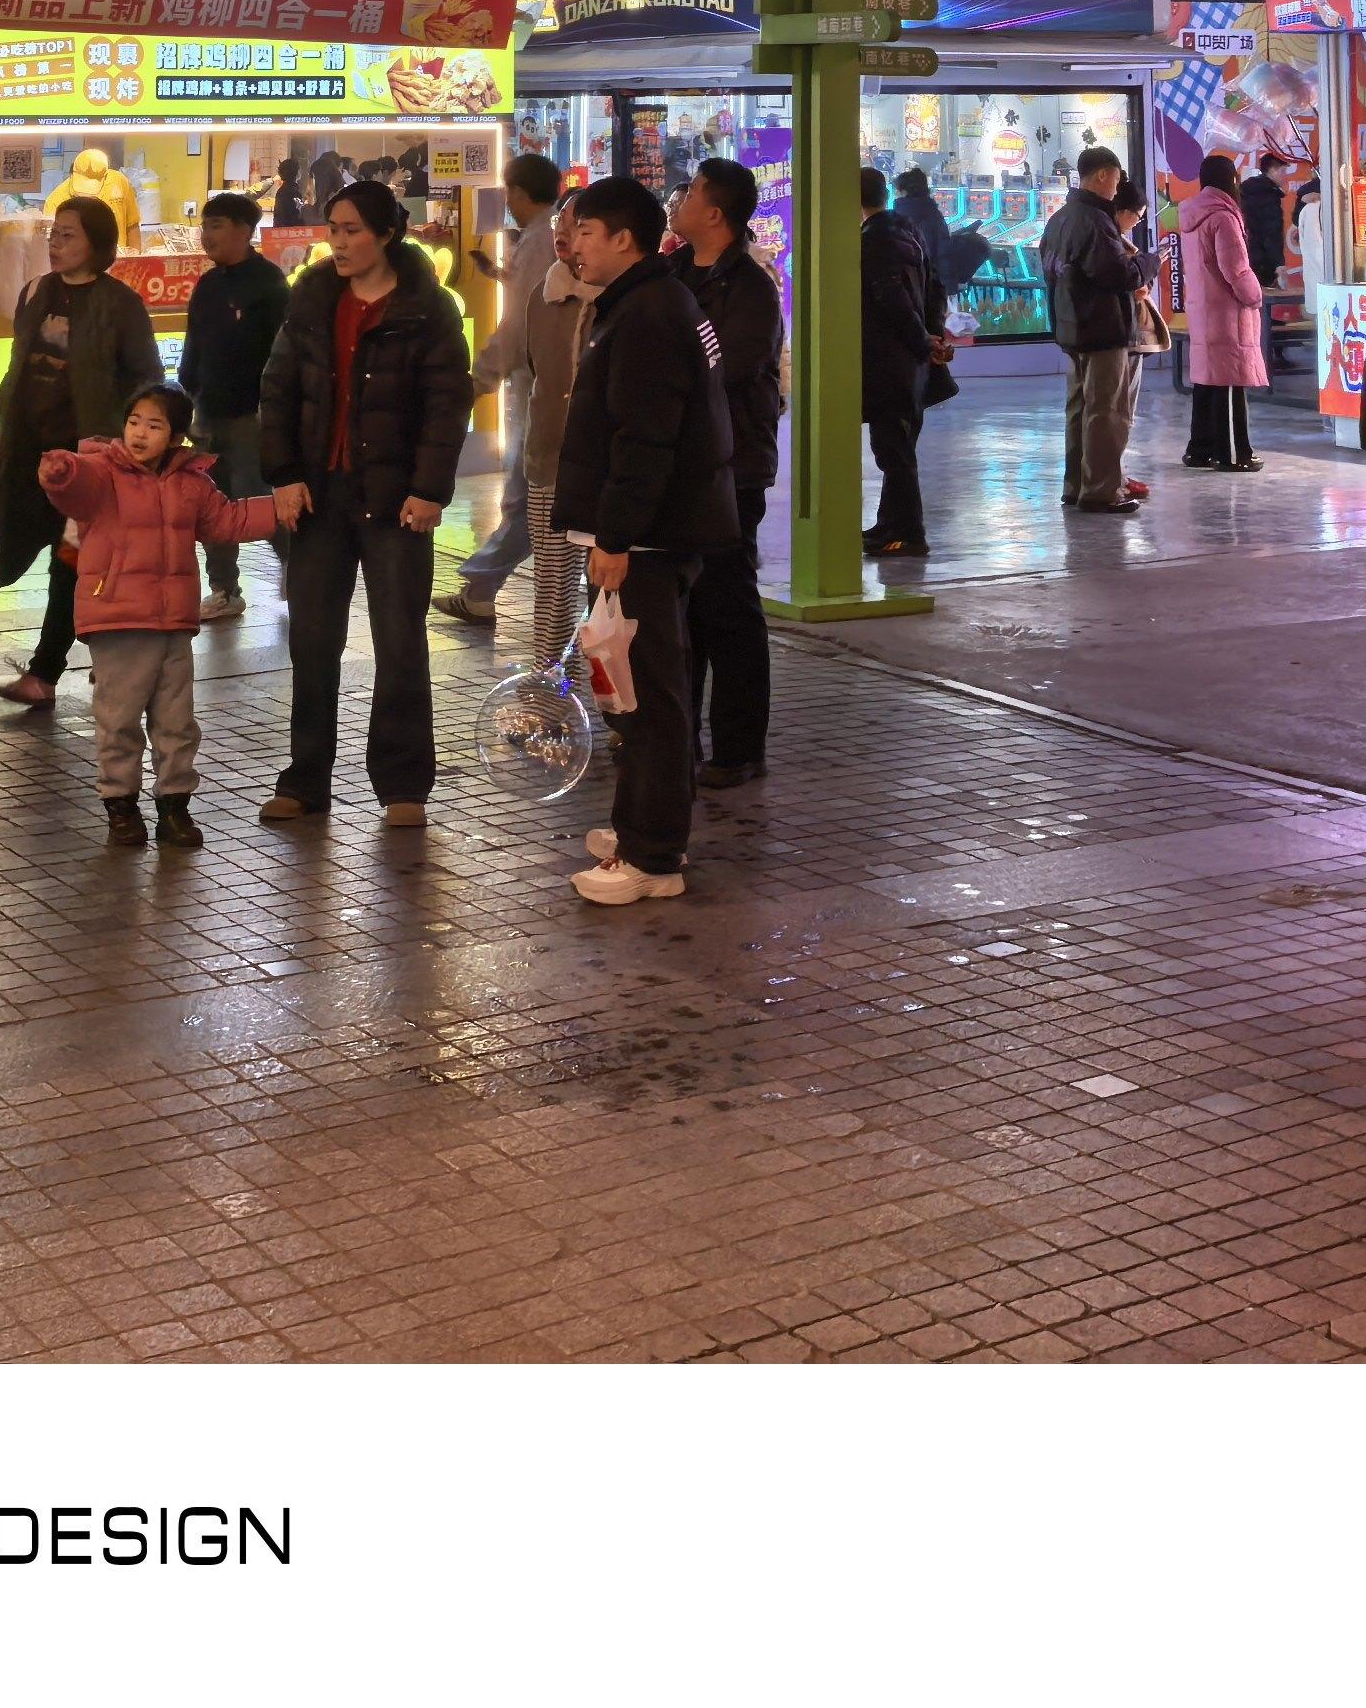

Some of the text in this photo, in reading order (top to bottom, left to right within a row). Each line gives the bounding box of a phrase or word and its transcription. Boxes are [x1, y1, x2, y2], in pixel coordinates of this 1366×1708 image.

[1197, 32, 1254, 51] 中贸广场
[155, 42, 346, 70] 招牌鸡柳四合一桶
[861, 49, 910, 66] 南忆巷
[88, 78, 139, 101] 现炸
[1169, 233, 1181, 314] BURGER
